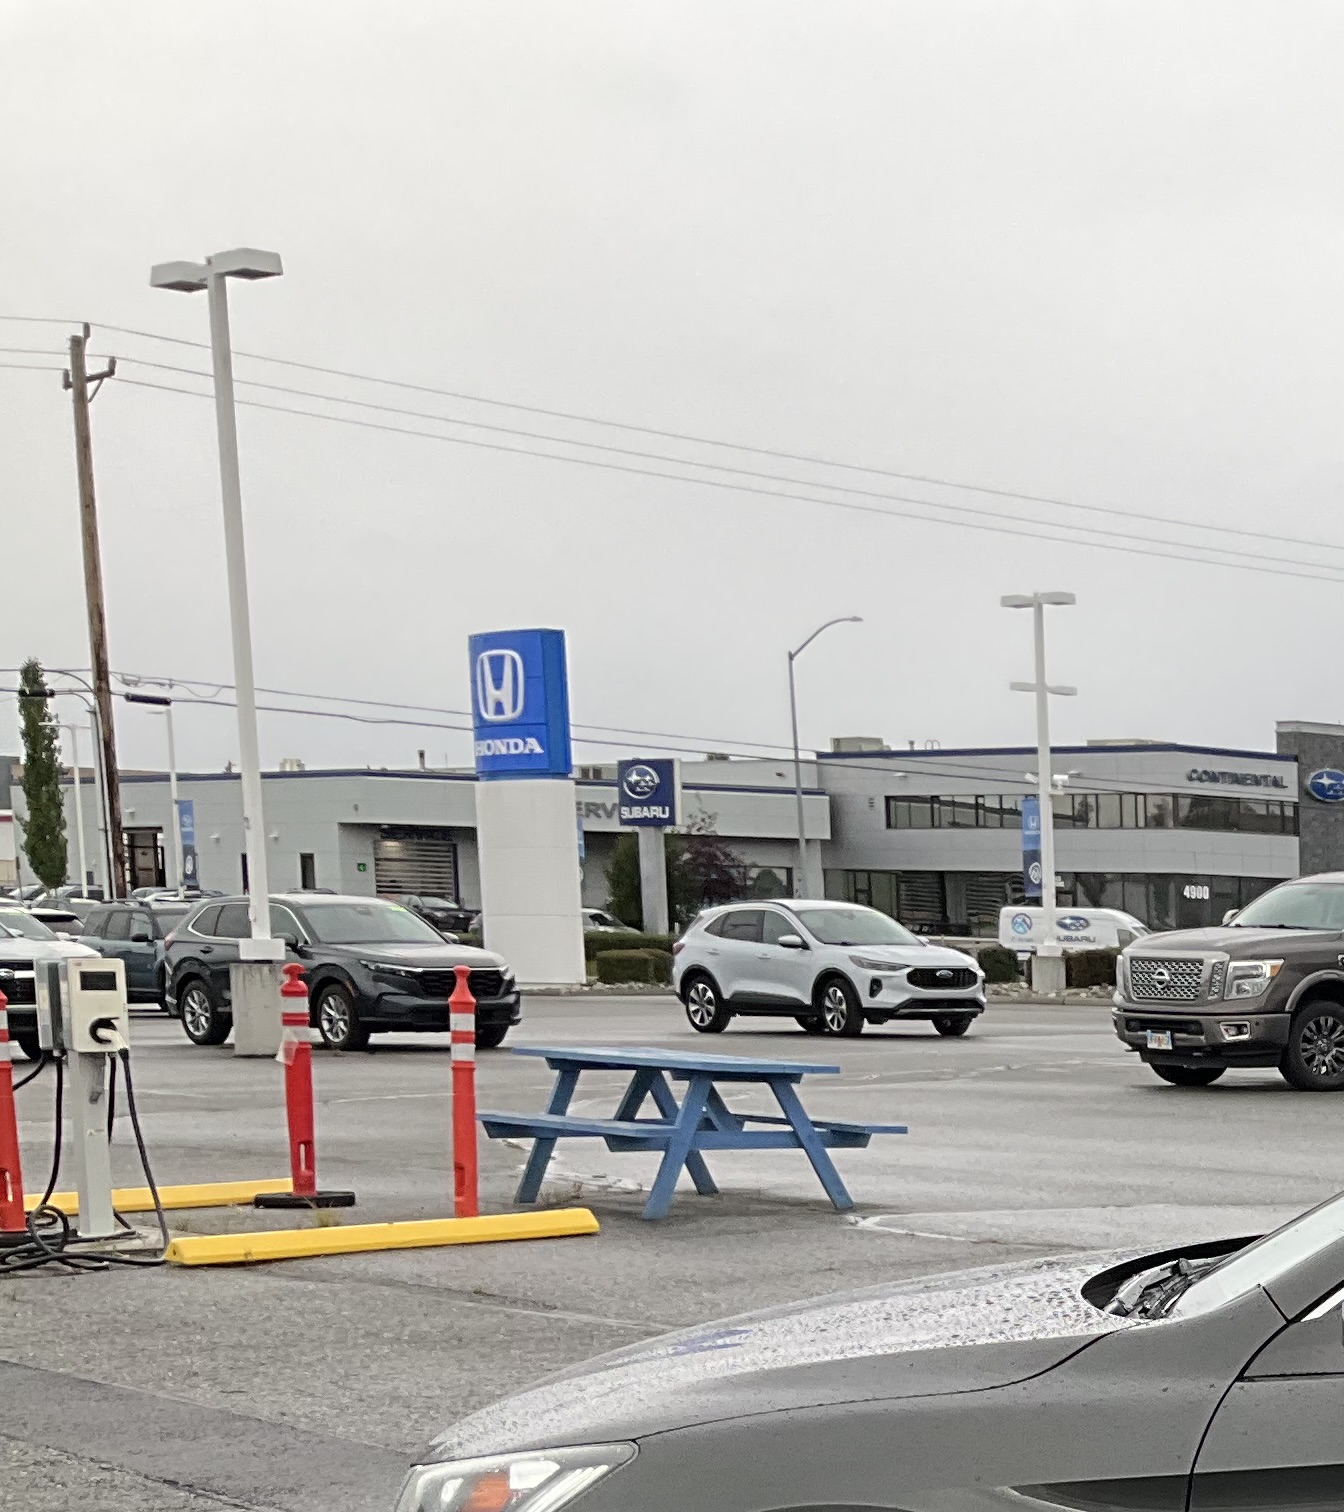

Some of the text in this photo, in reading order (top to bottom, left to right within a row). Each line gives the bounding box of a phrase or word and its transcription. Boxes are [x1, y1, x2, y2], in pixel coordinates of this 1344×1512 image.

[475, 737, 544, 756] HONDA
[1187, 768, 1289, 789] CONTINENTAL
[620, 805, 670, 819] SUBARU
[1183, 885, 1210, 900] 4900
[1056, 935, 1096, 943] UBARU
